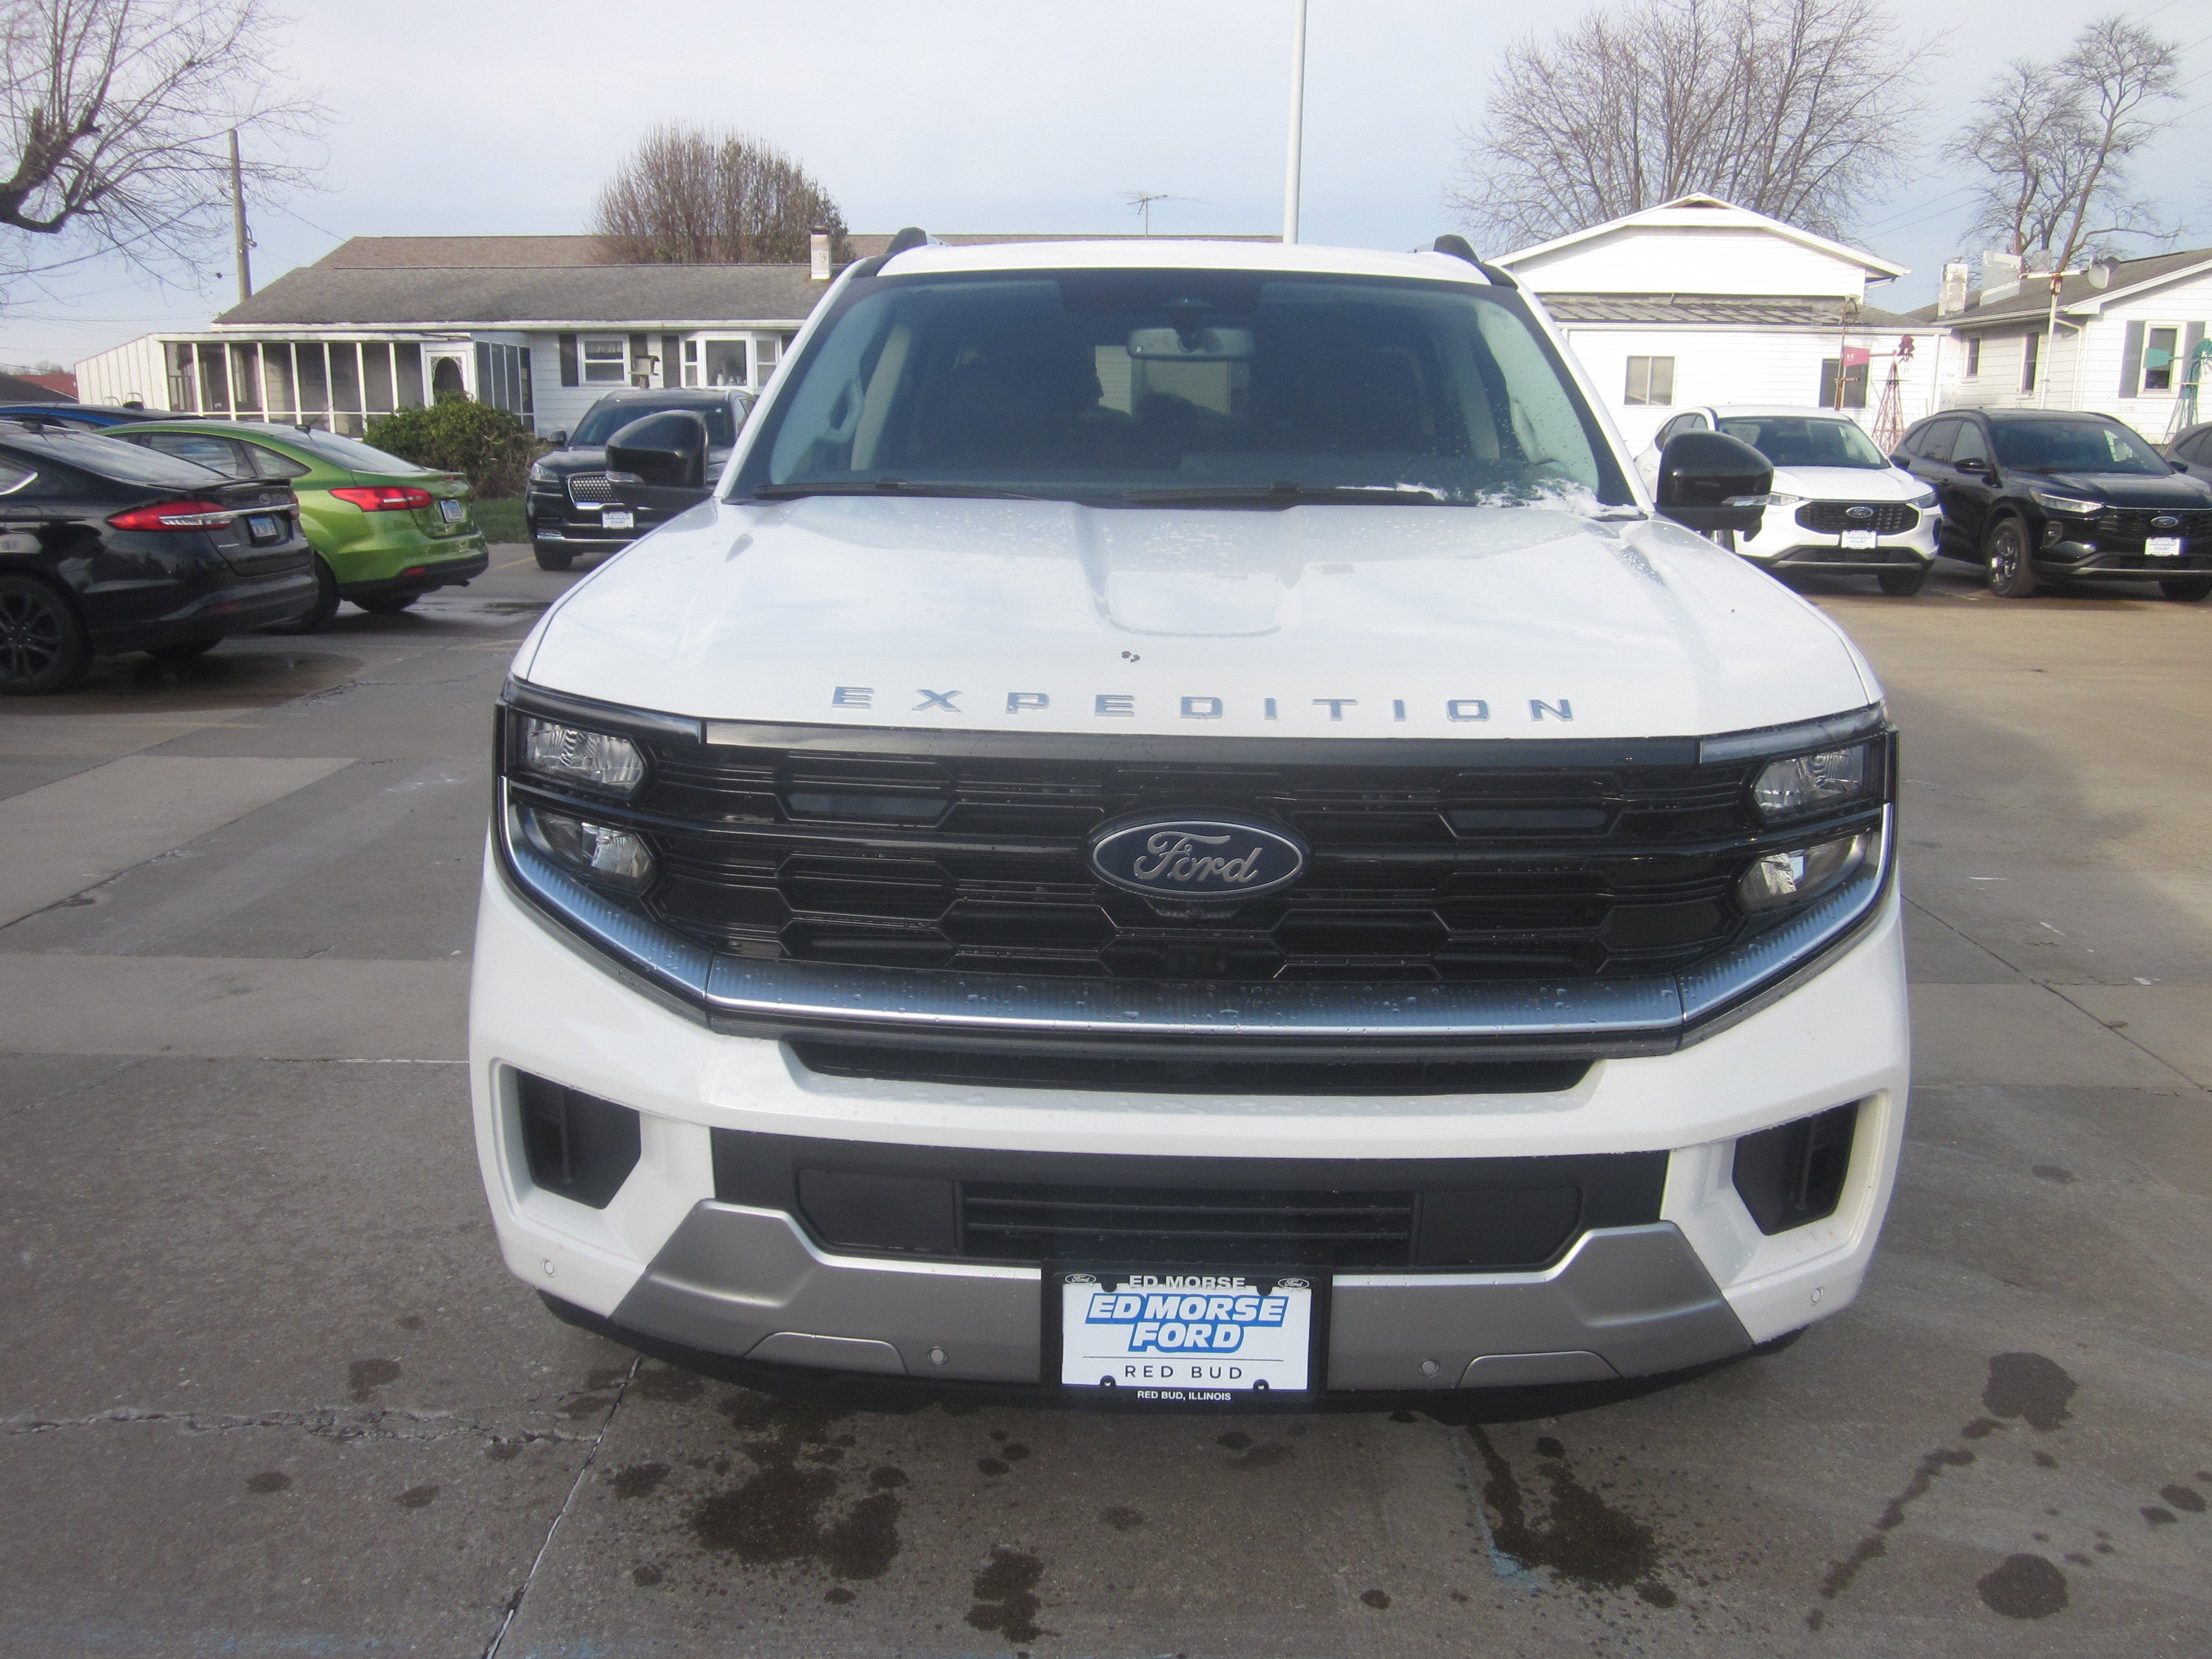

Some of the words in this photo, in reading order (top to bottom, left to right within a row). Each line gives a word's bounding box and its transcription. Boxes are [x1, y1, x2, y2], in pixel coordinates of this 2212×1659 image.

[831, 686, 1573, 722] EXPEDITION
[1134, 831, 1262, 883] Ford
[1130, 1275, 1157, 1287] ED
[1166, 1276, 1245, 1289] MORSE
[1284, 1278, 1302, 1287] Ford
[1087, 1295, 1143, 1321] ED
[1144, 1295, 1287, 1324] MORSE
[1130, 1322, 1242, 1350] FORD
[1125, 1365, 1173, 1378] RED
[1191, 1366, 1242, 1379] BUD
[1138, 1390, 1158, 1399] RED
[1161, 1391, 1186, 1401] BUD,
[1188, 1392, 1232, 1400] ILLINOIS
